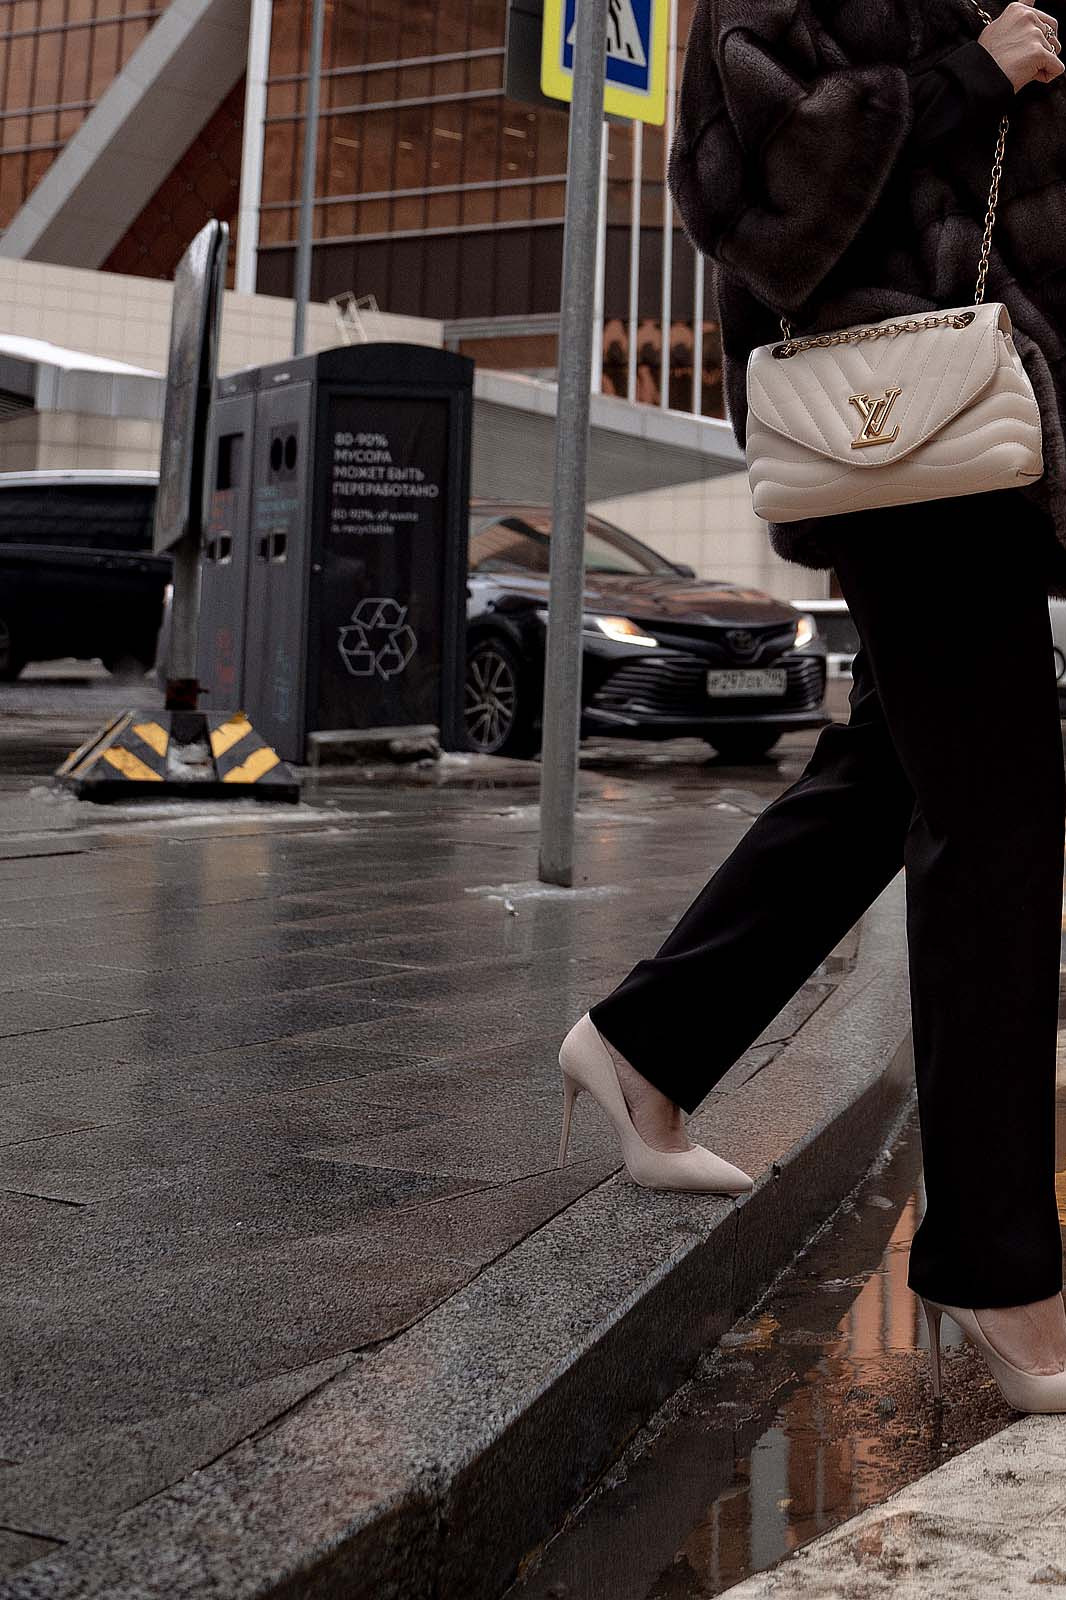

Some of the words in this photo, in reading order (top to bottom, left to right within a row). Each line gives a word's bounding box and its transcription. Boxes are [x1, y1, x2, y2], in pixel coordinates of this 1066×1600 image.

[334, 449, 393, 463] МУСОРА
[333, 465, 385, 480] МОЖЕТ
[386, 466, 425, 482] БЫТЬ
[332, 481, 439, 498] ПЕРЕРАБОТАНО
